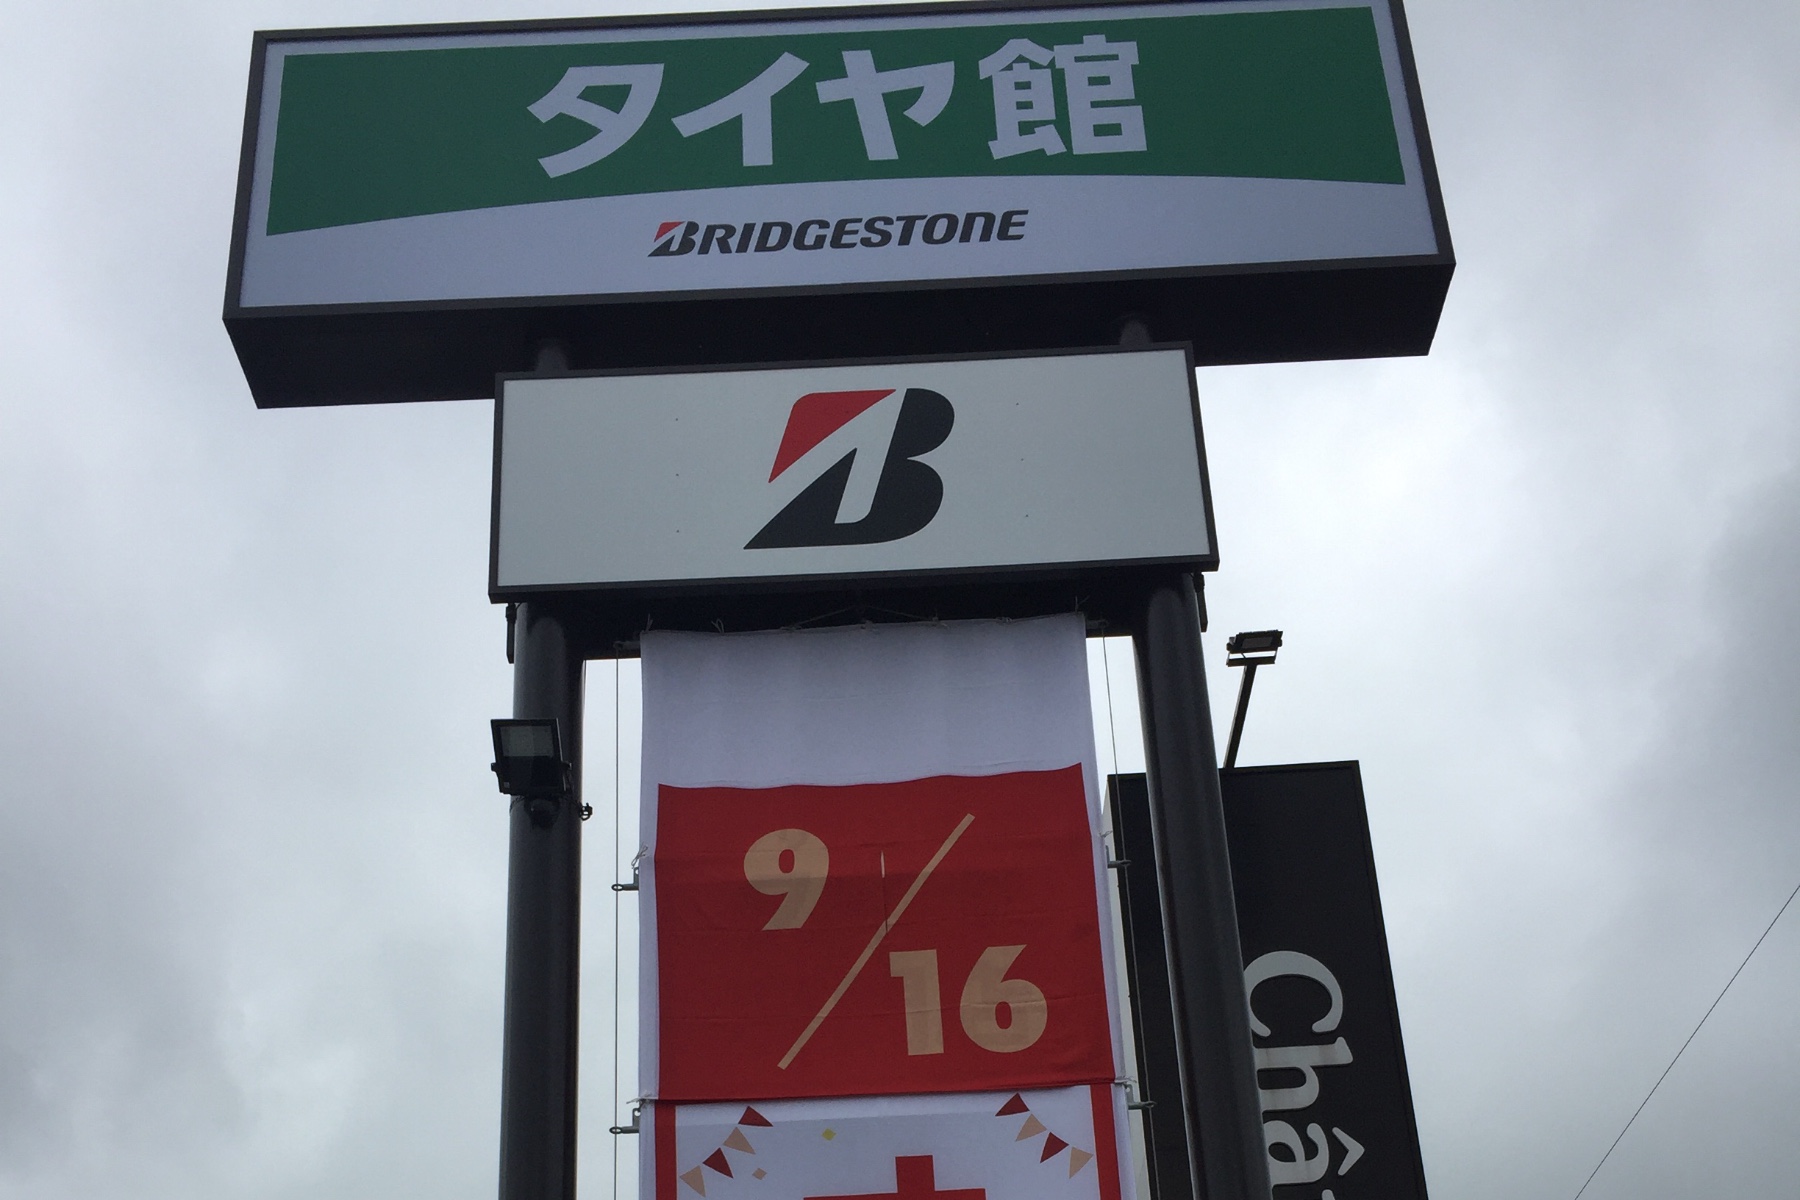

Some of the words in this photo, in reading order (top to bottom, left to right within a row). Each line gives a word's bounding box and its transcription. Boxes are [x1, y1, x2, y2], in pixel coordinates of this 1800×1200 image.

[528, 34, 1148, 179] タイヤ館
[648, 209, 1029, 257] BRIDGESTONE
[743, 812, 1048, 1070] 9/16
